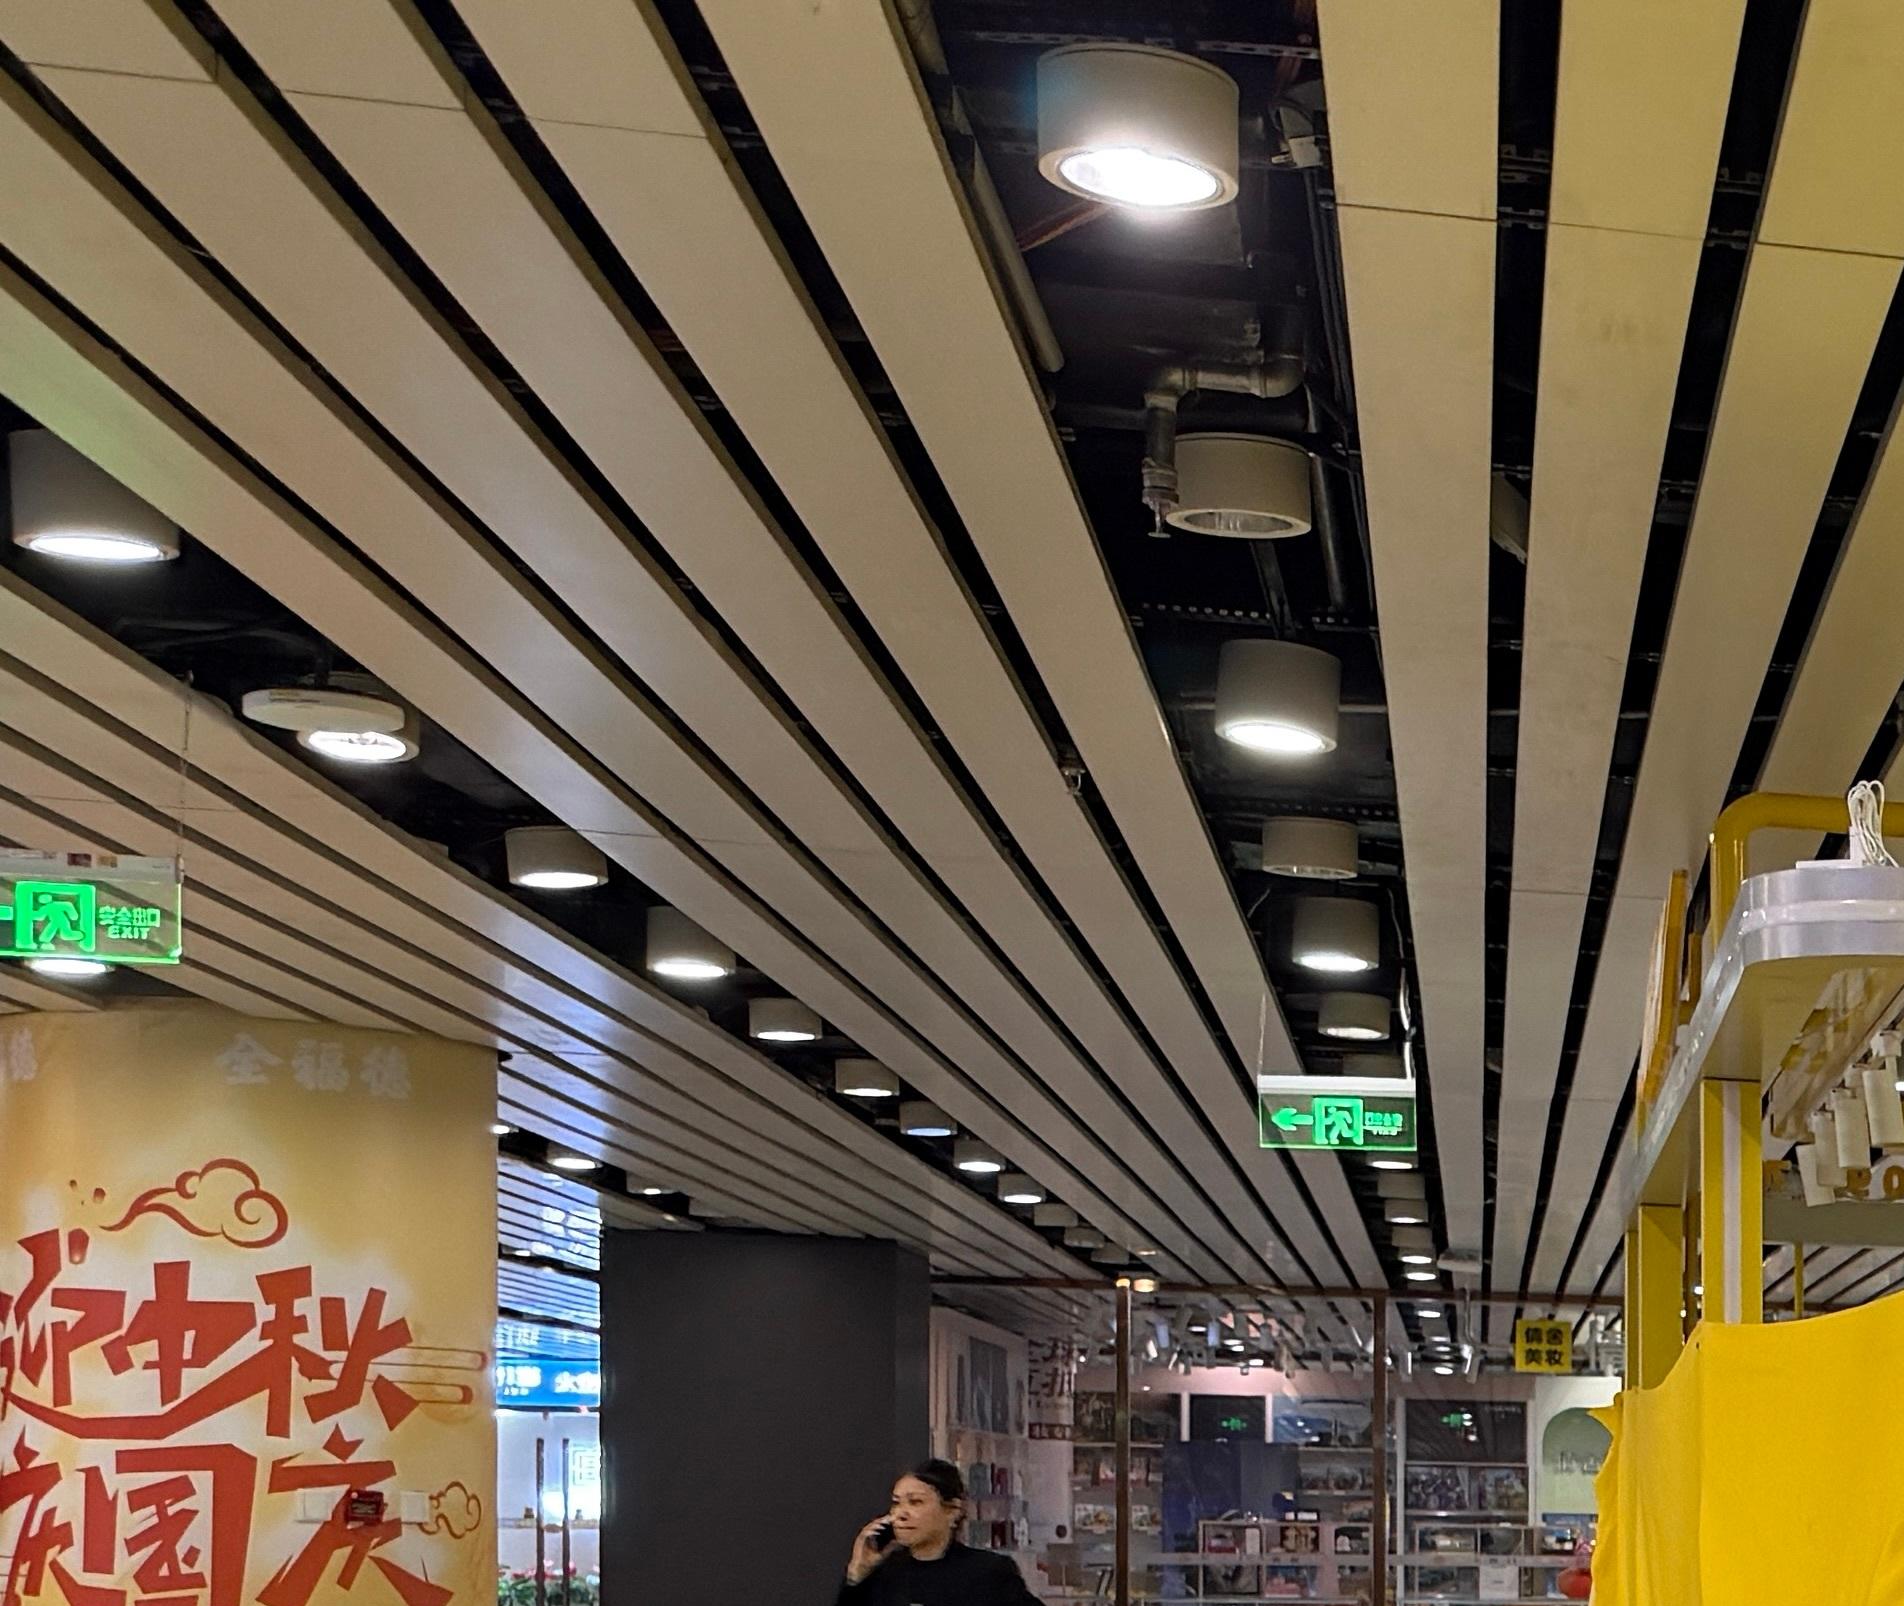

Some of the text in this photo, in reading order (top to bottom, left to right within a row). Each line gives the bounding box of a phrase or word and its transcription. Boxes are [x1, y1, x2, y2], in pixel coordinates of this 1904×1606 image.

[107, 926, 150, 939] EXIT
[0, 1229, 421, 1438] 迎中秋
